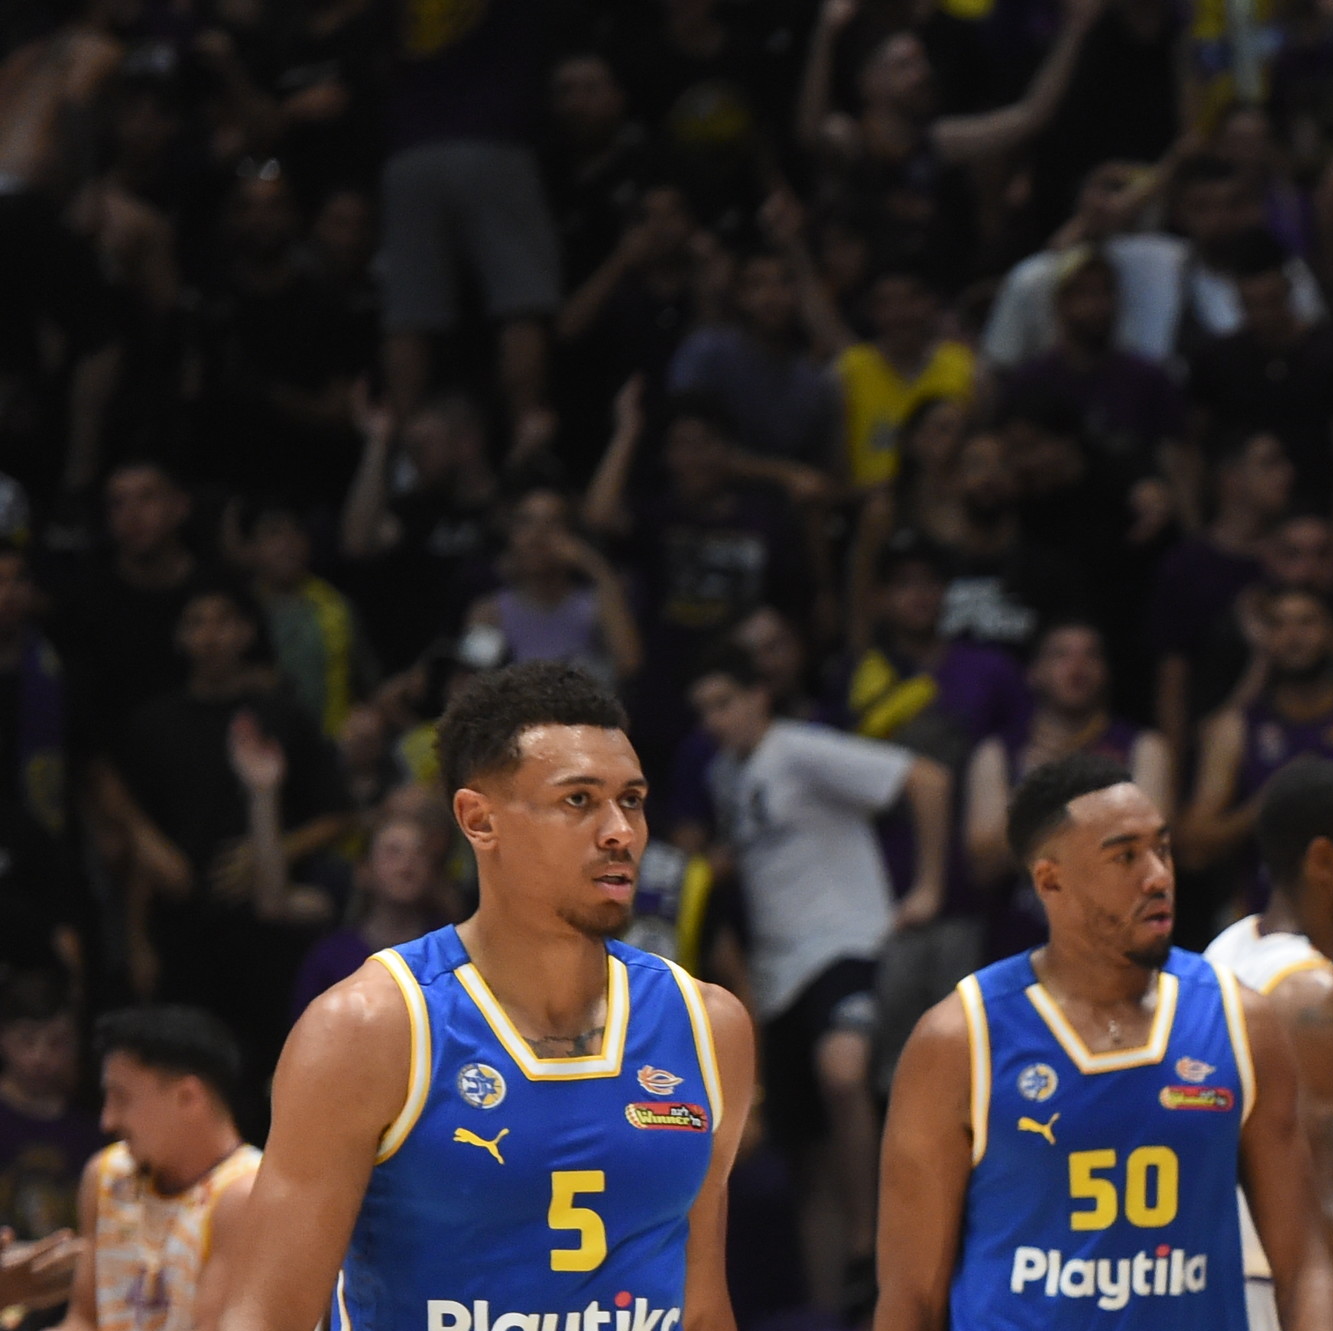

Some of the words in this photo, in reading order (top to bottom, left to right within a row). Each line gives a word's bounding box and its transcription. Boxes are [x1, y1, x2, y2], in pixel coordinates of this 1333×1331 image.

[636, 1109, 690, 1125] Winner
[547, 1170, 608, 1272] 5
[1068, 1146, 1179, 1231] 50
